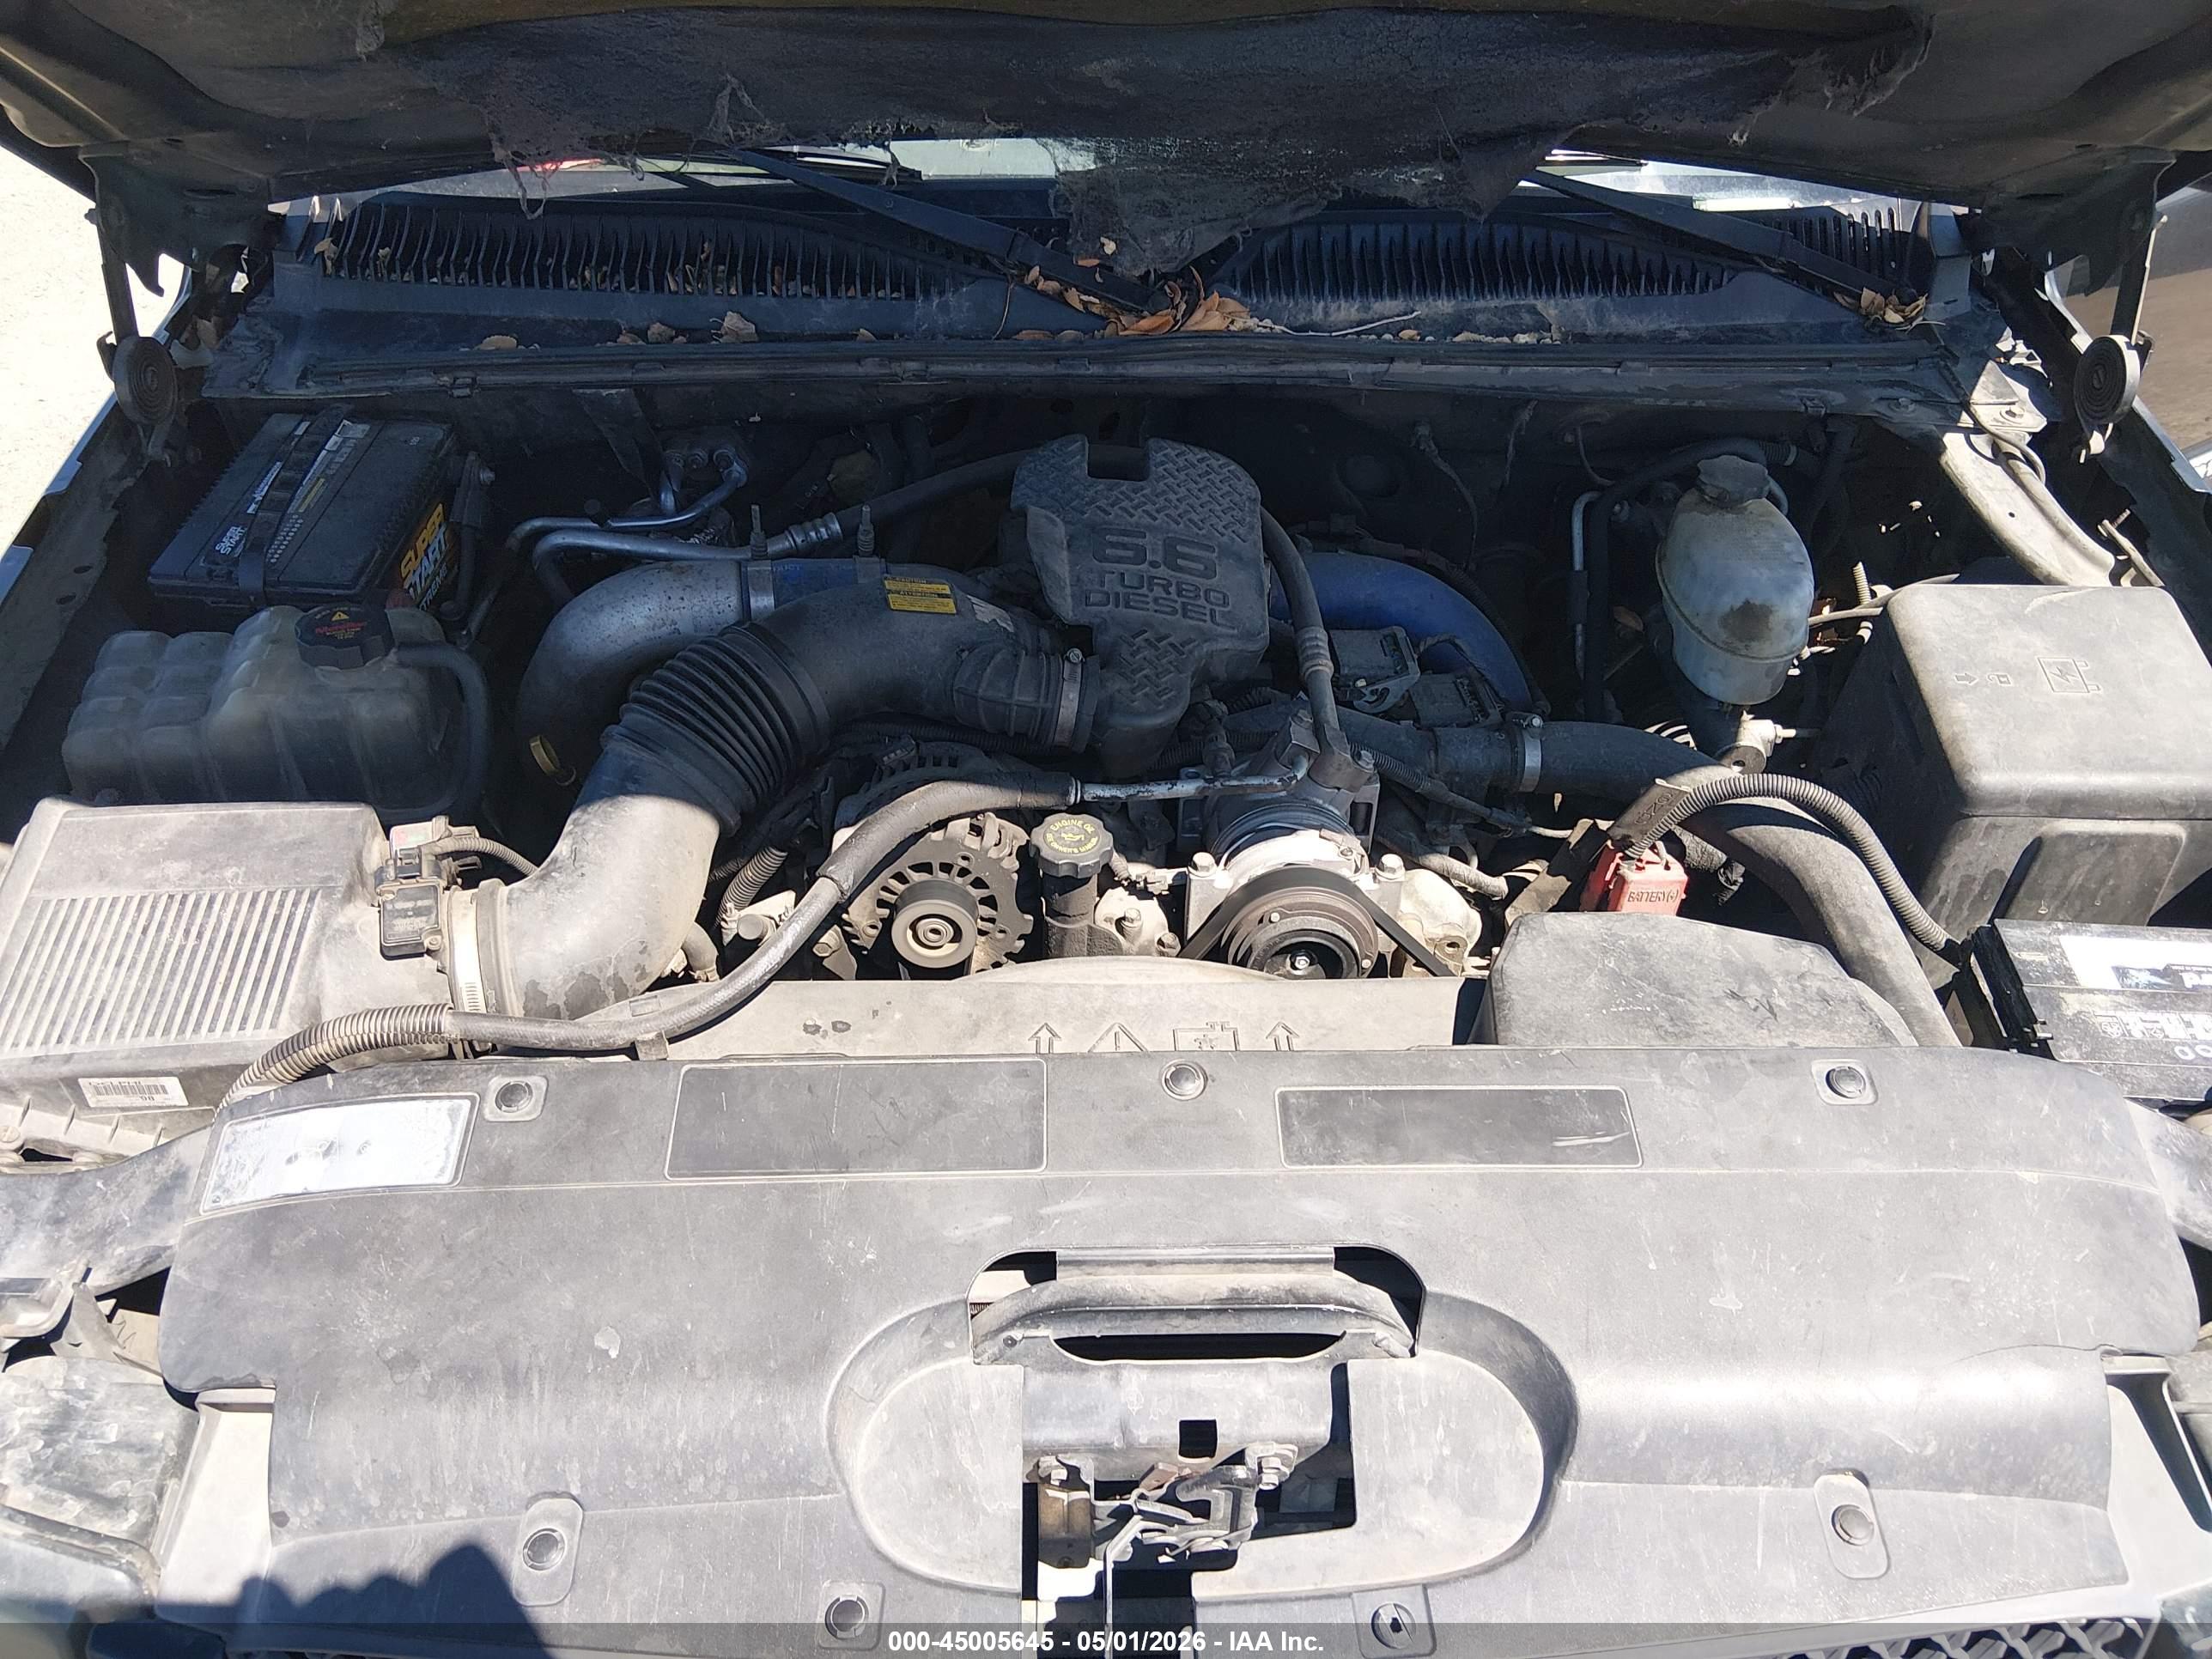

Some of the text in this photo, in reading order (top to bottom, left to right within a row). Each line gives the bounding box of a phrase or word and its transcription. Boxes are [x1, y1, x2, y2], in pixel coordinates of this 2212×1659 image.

[215, 526, 241, 550] SUPER
[220, 527, 246, 556] START
[400, 503, 445, 578] SUPER
[1092, 527, 1218, 580] 6.6
[1101, 570, 1231, 608] TURBO
[1085, 589, 1237, 632] DIESEL
[1049, 818, 1096, 835] ENGINE OIL
